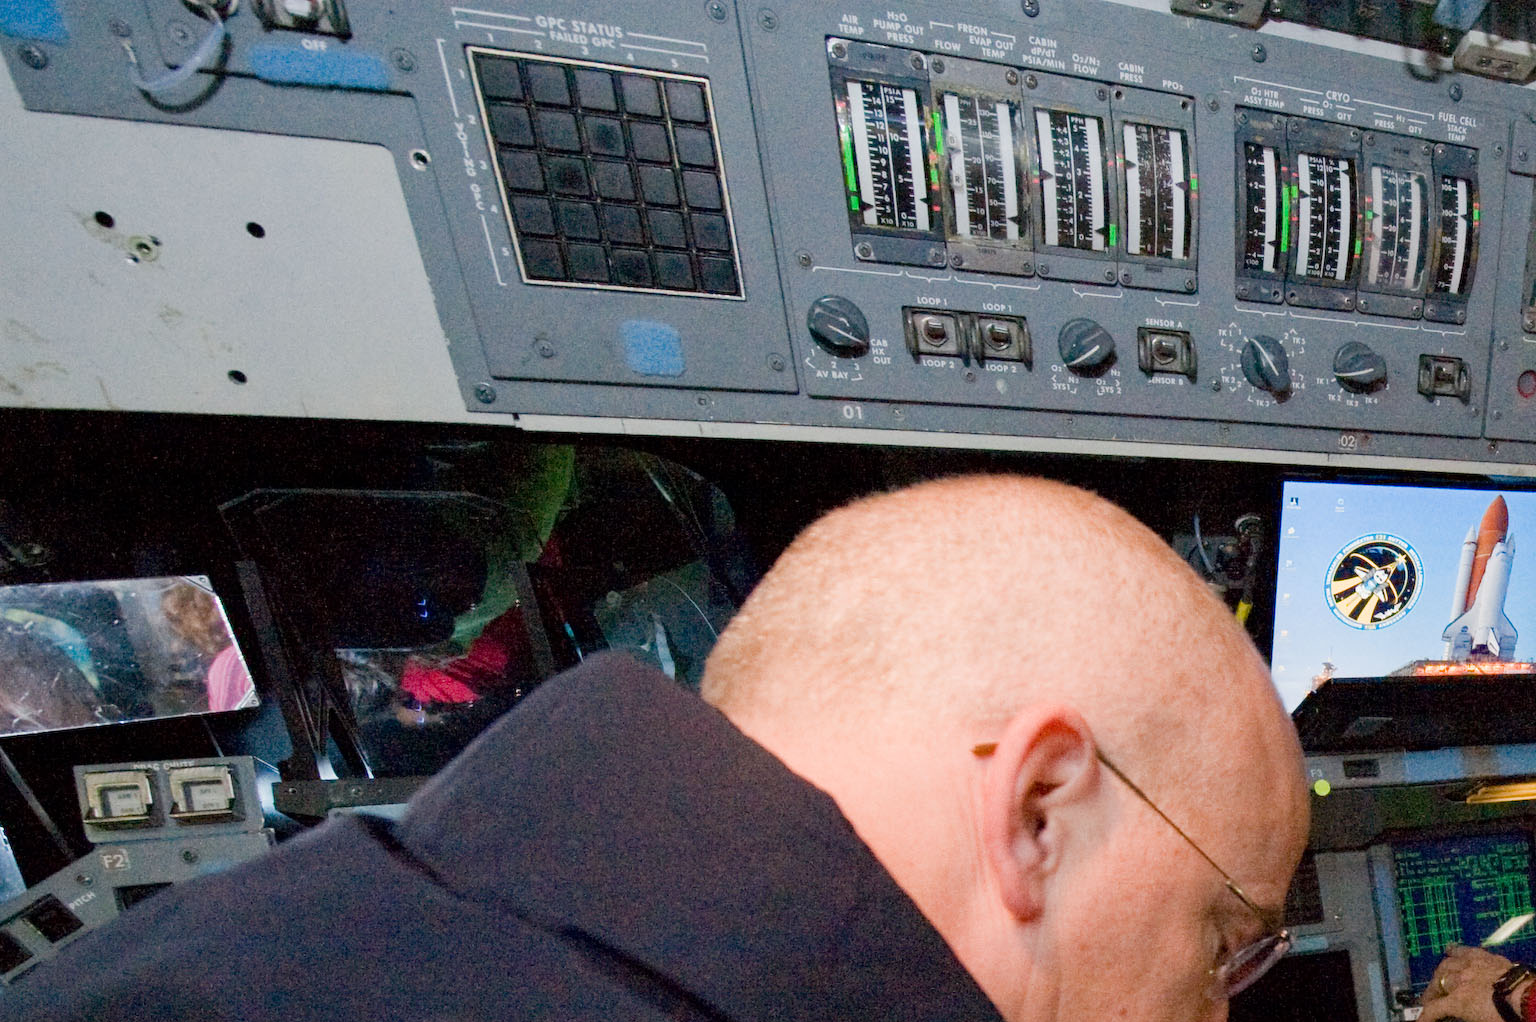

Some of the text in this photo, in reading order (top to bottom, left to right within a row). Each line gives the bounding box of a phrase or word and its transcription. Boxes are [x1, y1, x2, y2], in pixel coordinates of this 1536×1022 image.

[842, 14, 858, 24] AIR
[535, 15, 623, 38] GPC STATUS
[839, 23, 864, 36] TEMP
[873, 19, 924, 36] PUMP OUT
[957, 24, 988, 36] FREON
[488, 33, 494, 42] 1
[550, 31, 616, 49] FAILED GPC
[887, 32, 914, 44] PRESS
[1028, 36, 1057, 49] CABIN
[535, 40, 543, 49] 2
[935, 40, 961, 52] FLOW
[969, 36, 1014, 51] EVAP OUT
[583, 47, 589, 56] 3
[982, 48, 1006, 59] TEMP
[627, 53, 635, 62] 4
[1022, 54, 1066, 70] PSIA/MIN
[671, 58, 679, 69] 5
[1118, 62, 1145, 74] CABIN
[458, 69, 466, 79] 1
[1073, 63, 1099, 76] FLOW
[1119, 72, 1143, 84] PRESS
[884, 86, 901, 95] PSIA
[1244, 95, 1285, 109] ASSY TEMP
[1326, 90, 1350, 103] CRYO
[1303, 106, 1324, 117] PRESS
[1337, 112, 1353, 121] QTY
[468, 115, 477, 125] 2
[1374, 119, 1395, 130] PRESS
[1438, 112, 1477, 128] FUEL CELL
[1408, 125, 1423, 135] QTY
[1447, 123, 1468, 135] STACK
[1448, 132, 1466, 143] TEMP
[454, 122, 485, 211] VOTING GPC
[479, 160, 487, 170] 3
[490, 205, 498, 213] 4
[917, 296, 939, 306] LOOP
[982, 302, 1004, 312] LOOP
[1145, 318, 1183, 329] SENSOR A
[870, 338, 889, 348] CAB
[872, 347, 886, 357] HX
[873, 356, 892, 366] OUT
[922, 359, 955, 370] LOOP 2
[985, 363, 1018, 374] LOOP 2
[816, 369, 849, 381] AV BAY
[1101, 386, 1114, 394] SYS
[102, 854, 126, 870] F2
[67, 891, 97, 911] PITCH
